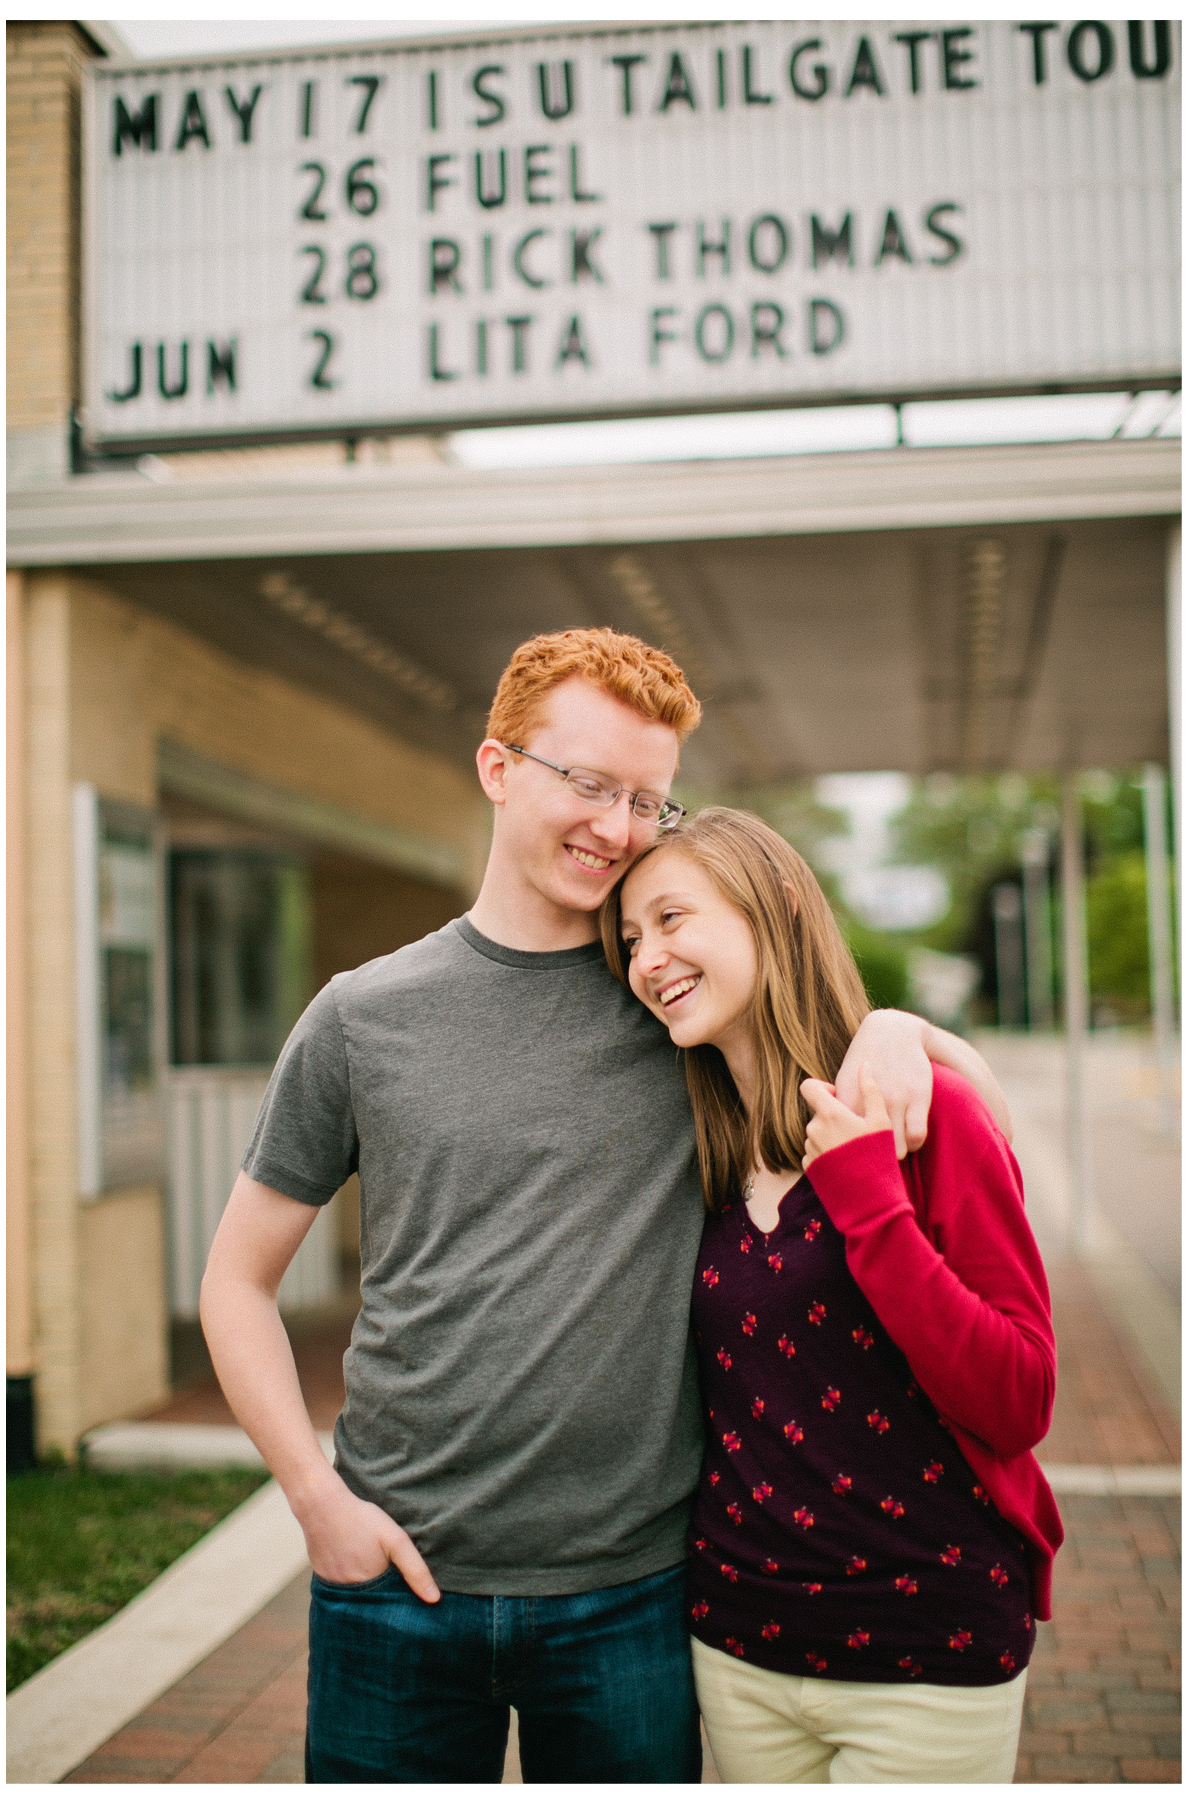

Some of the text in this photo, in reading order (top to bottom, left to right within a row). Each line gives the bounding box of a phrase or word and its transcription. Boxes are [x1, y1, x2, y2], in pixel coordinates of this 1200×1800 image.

[112, 82, 267, 157] MAY
[298, 73, 388, 142] 17
[603, 24, 984, 118] TAILGATE
[296, 143, 599, 226] 26 FUEL
[297, 200, 967, 308] 28 RICK THOMAS
[103, 297, 847, 407] JUN 2 LITA FORD
